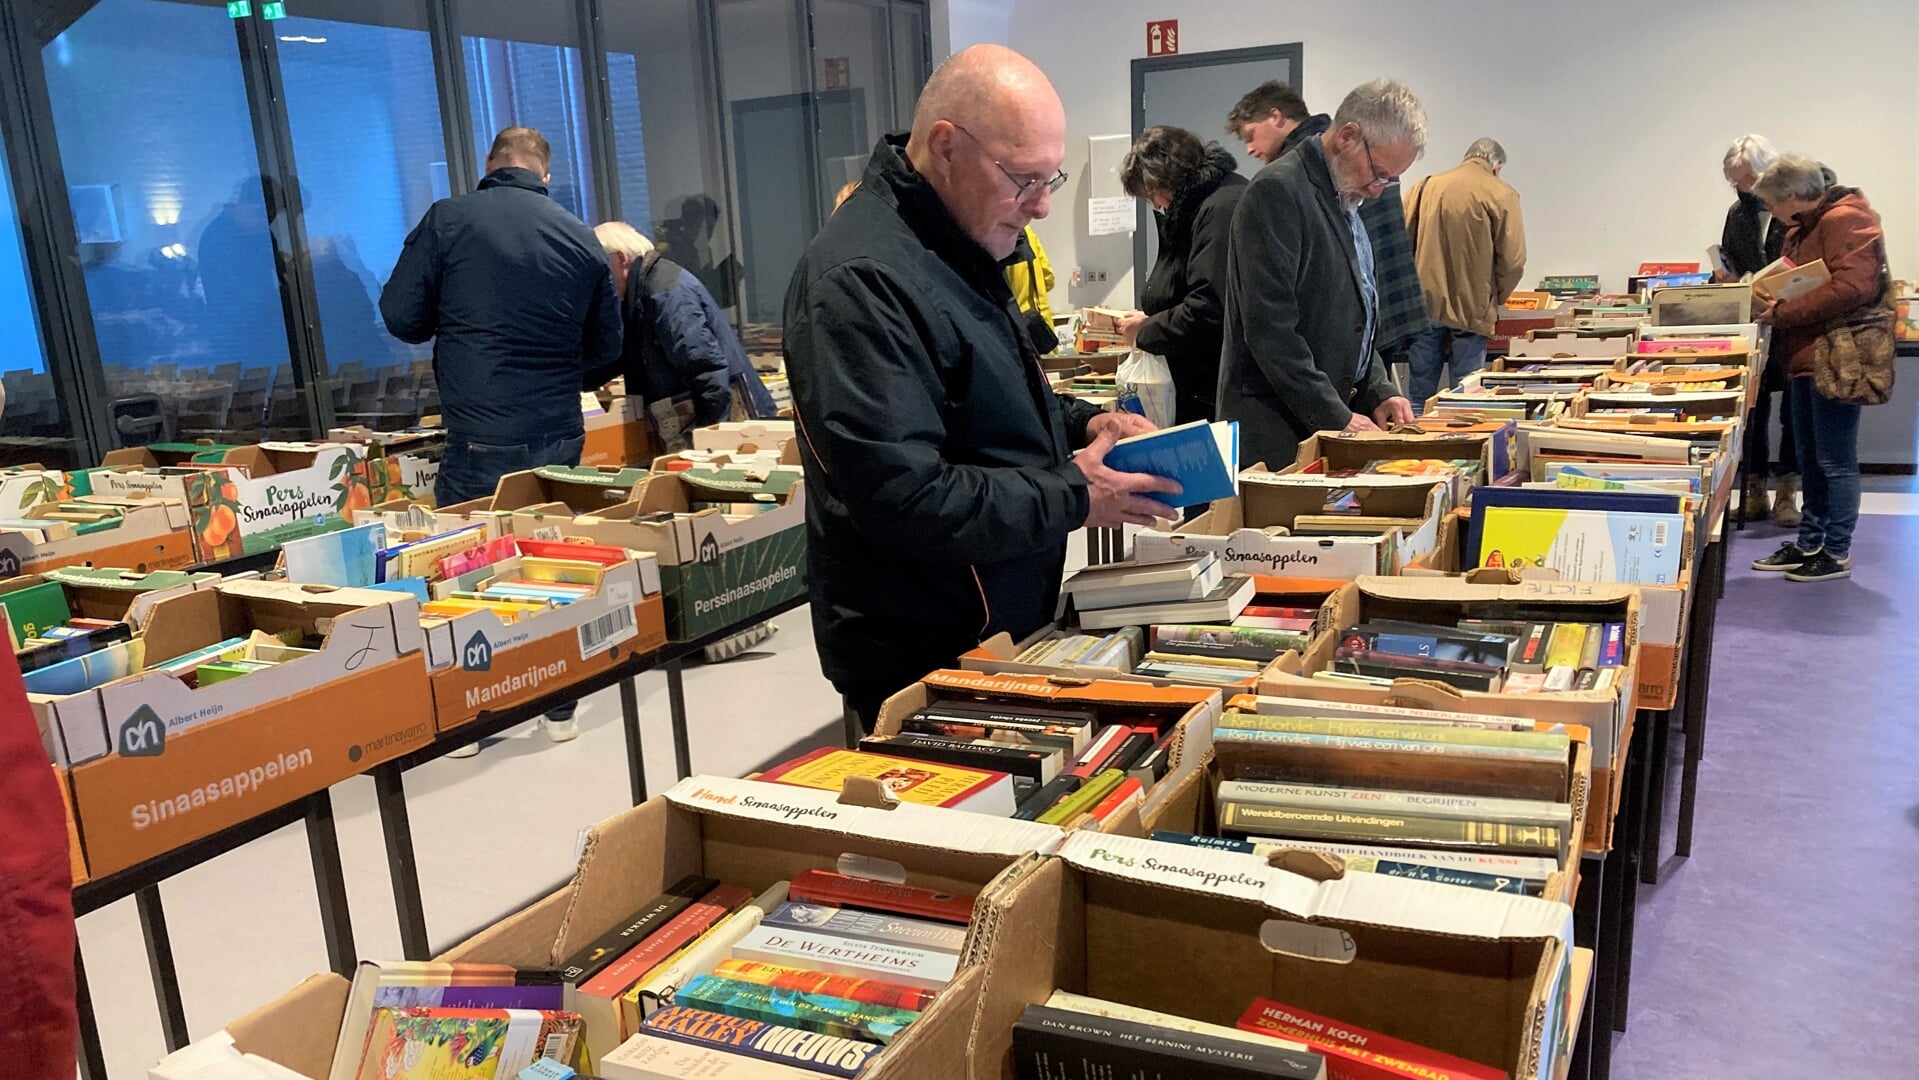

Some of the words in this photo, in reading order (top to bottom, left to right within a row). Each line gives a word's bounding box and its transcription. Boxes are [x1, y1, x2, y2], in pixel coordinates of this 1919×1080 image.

[244, 494, 332, 522] Sinaasappelen
[266, 486, 304, 506] Pers
[1225, 548, 1318, 570] Sinaasappelen
[694, 563, 797, 617] Perssinaasappelen
[493, 637, 512, 649] Albert
[514, 632, 529, 642] Heijn
[465, 659, 567, 709] Mandarijnen
[929, 674, 1054, 694] Mandarijnen
[168, 712, 198, 728] Albert
[200, 704, 224, 718] Heijn
[1231, 714, 1256, 728] Rien
[1260, 717, 1313, 732] Poortvliet
[366, 721, 426, 754] martinavarro
[1227, 729, 1253, 740] Rien
[1256, 732, 1312, 745] Poortvliet
[130, 747, 314, 830] Sinaasappelen
[1236, 784, 1302, 796] MODERNE
[1304, 788, 1349, 798] KUNST
[1351, 792, 1382, 800] ZIEN
[1407, 795, 1478, 808] BEGRIJPEN
[690, 788, 738, 806] Hand
[740, 796, 838, 820] Sinaasappelen
[1241, 808, 1334, 822] Wereldberoemde
[1336, 814, 1404, 828] Uitvindingen
[1190, 835, 1241, 848] Ruimte
[1360, 849, 1428, 860] HANDBOEK
[1090, 846, 1136, 870] Pers
[1142, 857, 1266, 889] Sinaasappelen
[1436, 874, 1473, 886] Gorter
[765, 936, 794, 948] DE
[800, 940, 920, 968] WERTHEIMS
[736, 991, 755, 1000] HET
[648, 1012, 755, 1046] HAILEY
[664, 1005, 765, 1030] ARTHUR
[1262, 1006, 1324, 1032] HERMAN
[1327, 1026, 1368, 1046] KOCH
[754, 1025, 878, 1070] NIEUWS
[1042, 1019, 1066, 1030] DAN
[1068, 1024, 1112, 1038] BROWN
[1120, 1032, 1141, 1042] HET
[1145, 1037, 1192, 1051] BERNINI
[1195, 1046, 1254, 1062] MYSTERIE
[1256, 1018, 1337, 1048] ZOMERHUIS
[1338, 1044, 1371, 1060] MET
[1372, 1053, 1450, 1080] ZWEMBAD
